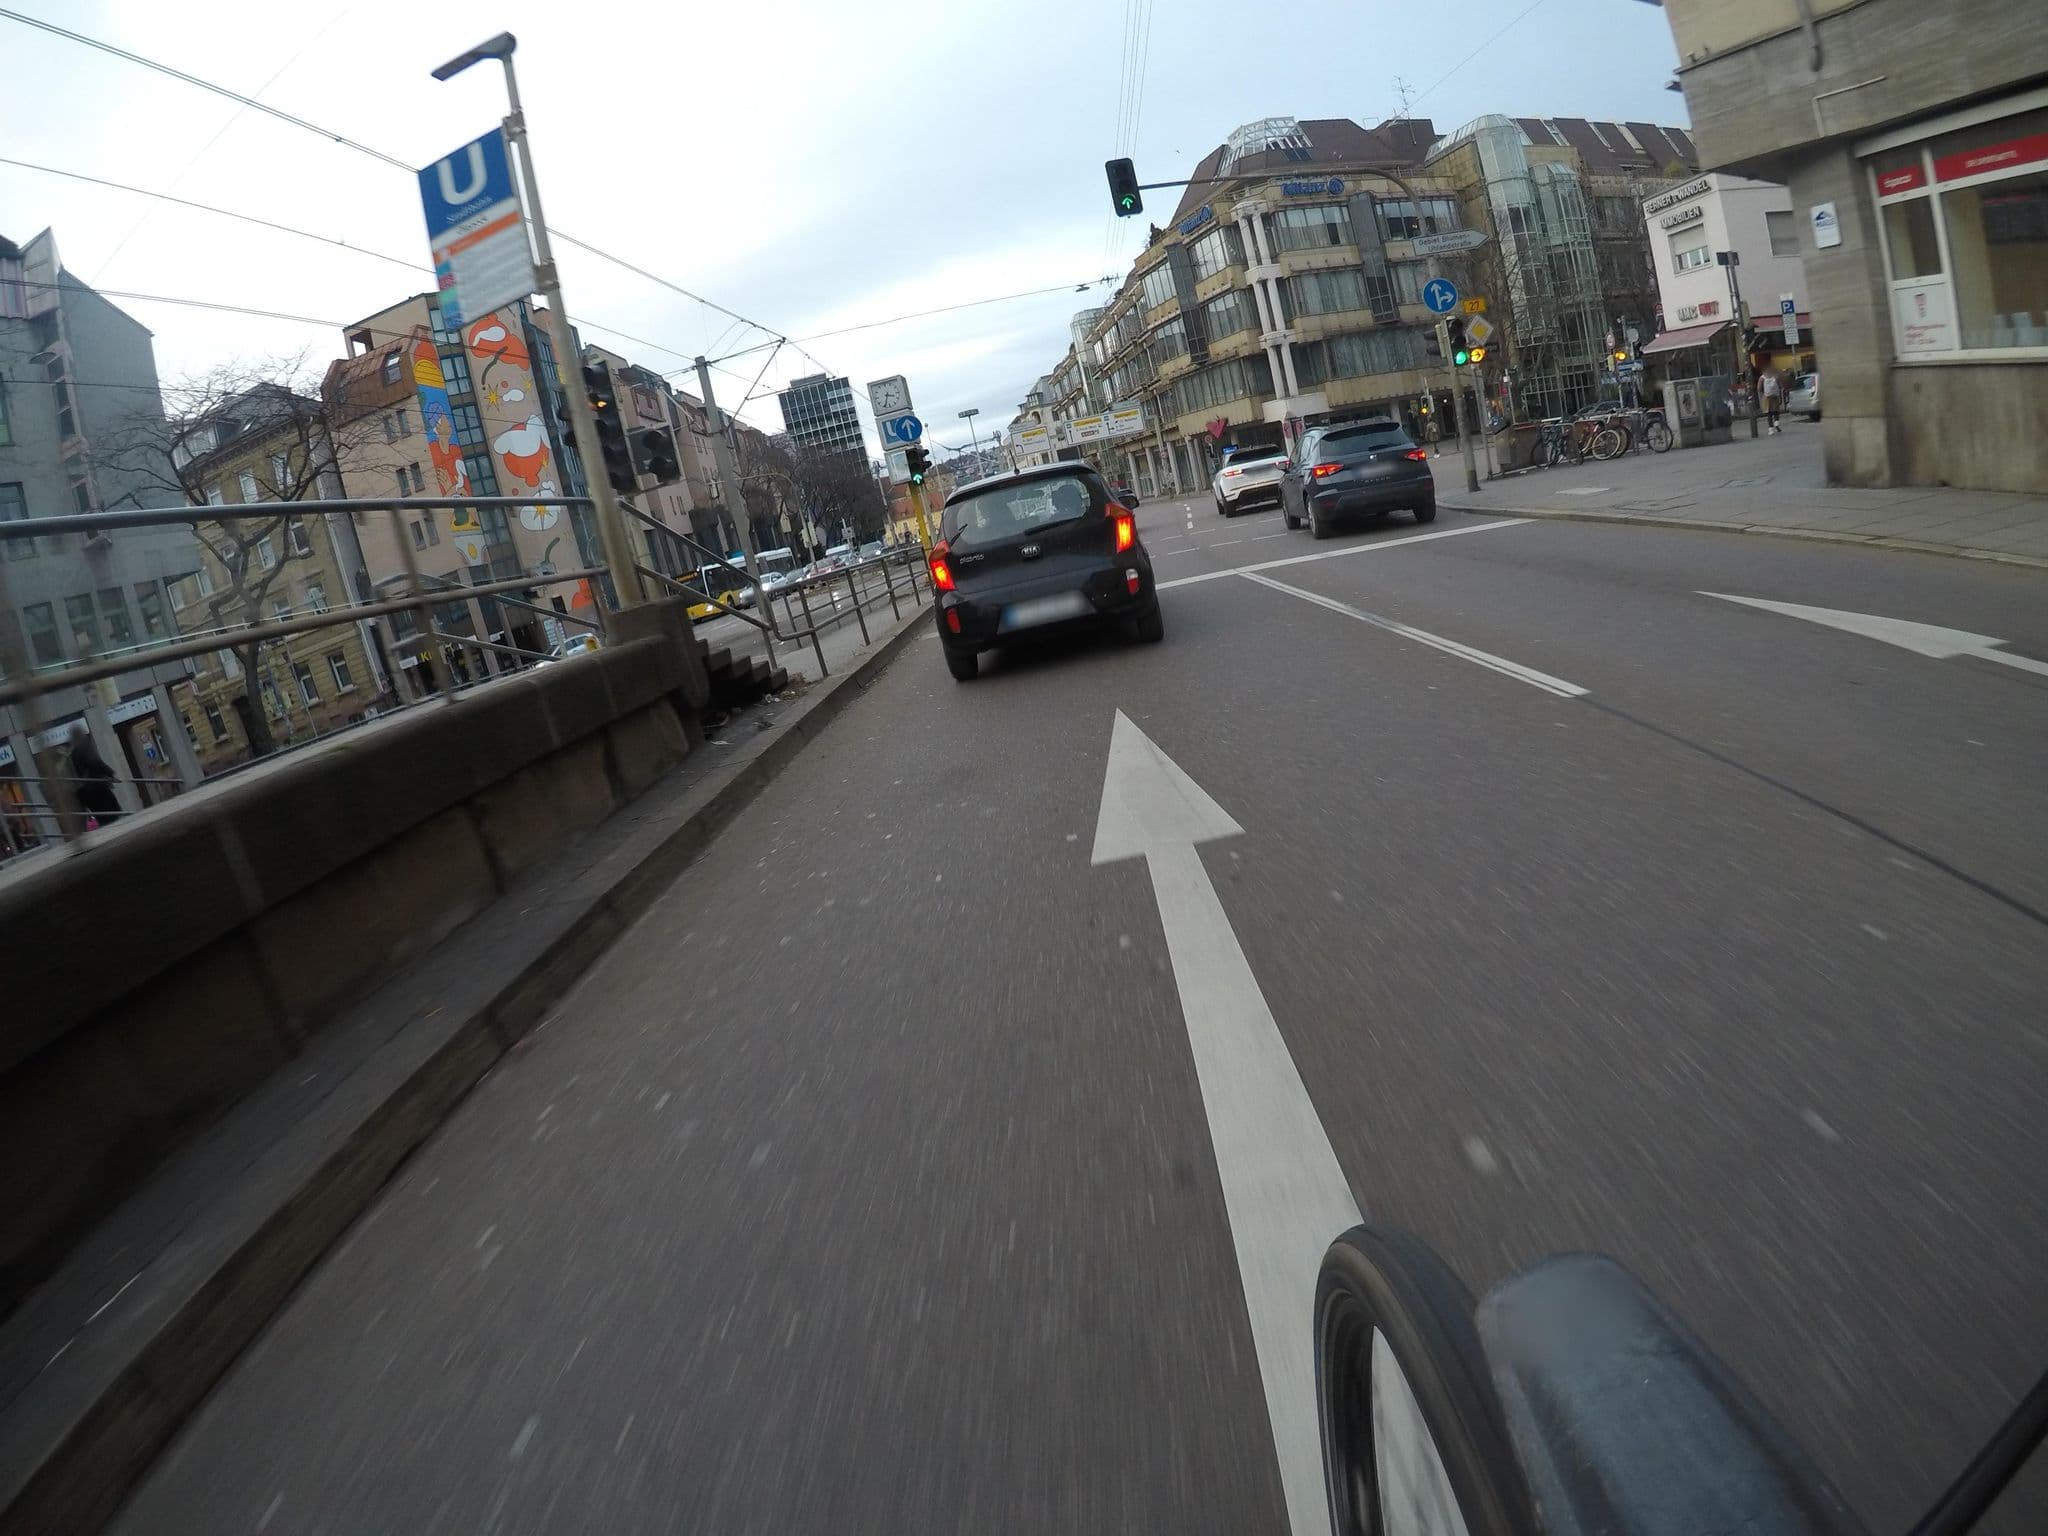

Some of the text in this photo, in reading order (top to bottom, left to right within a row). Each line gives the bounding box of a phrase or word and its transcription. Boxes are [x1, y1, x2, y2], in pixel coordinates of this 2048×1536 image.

[437, 141, 487, 205] U
[1679, 180, 1710, 201] WANDEL
[1418, 237, 1440, 246] Gebiet
[1469, 301, 1479, 311] 27
[1782, 302, 1790, 312] P
